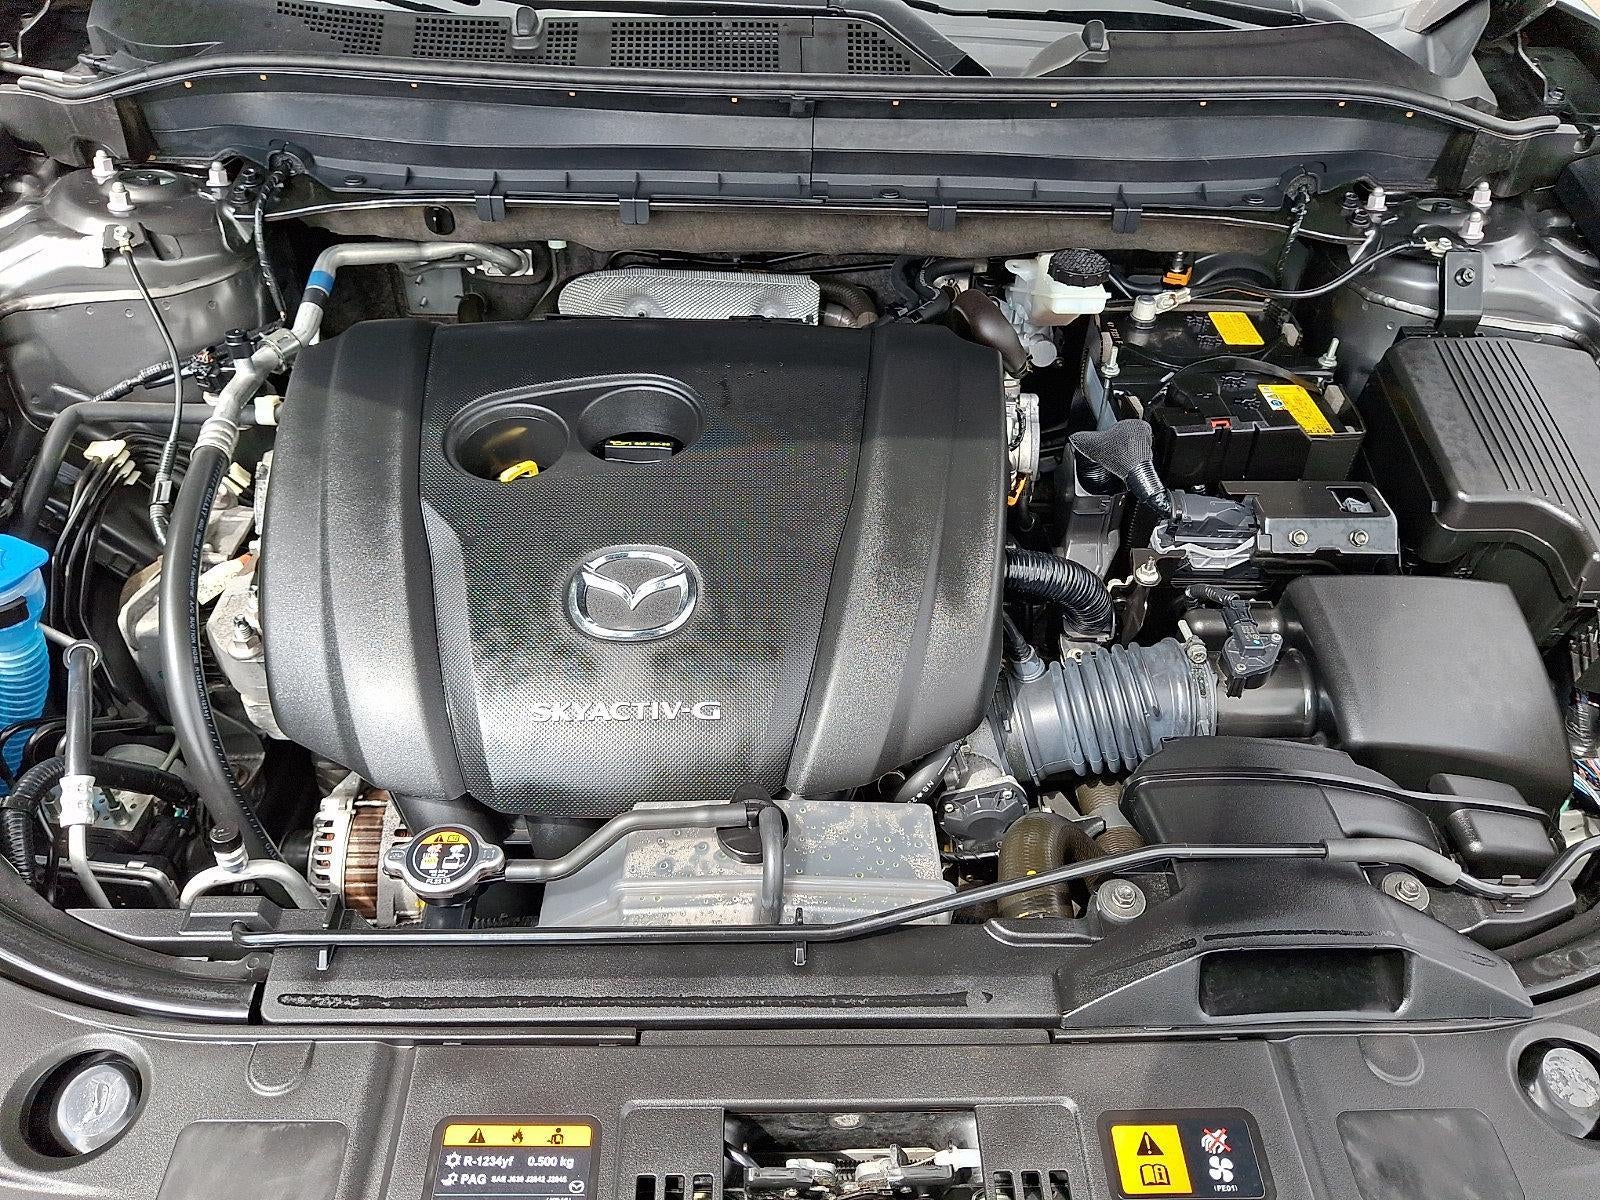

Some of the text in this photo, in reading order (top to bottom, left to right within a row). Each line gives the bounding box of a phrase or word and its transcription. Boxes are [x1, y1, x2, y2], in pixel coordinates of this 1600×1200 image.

[189, 615, 198, 645] SUCTION
[533, 701, 721, 721] SKYACTIV-G
[463, 1155, 575, 1169] R-1234yf 0.500 kg
[460, 1173, 487, 1186] PAG
